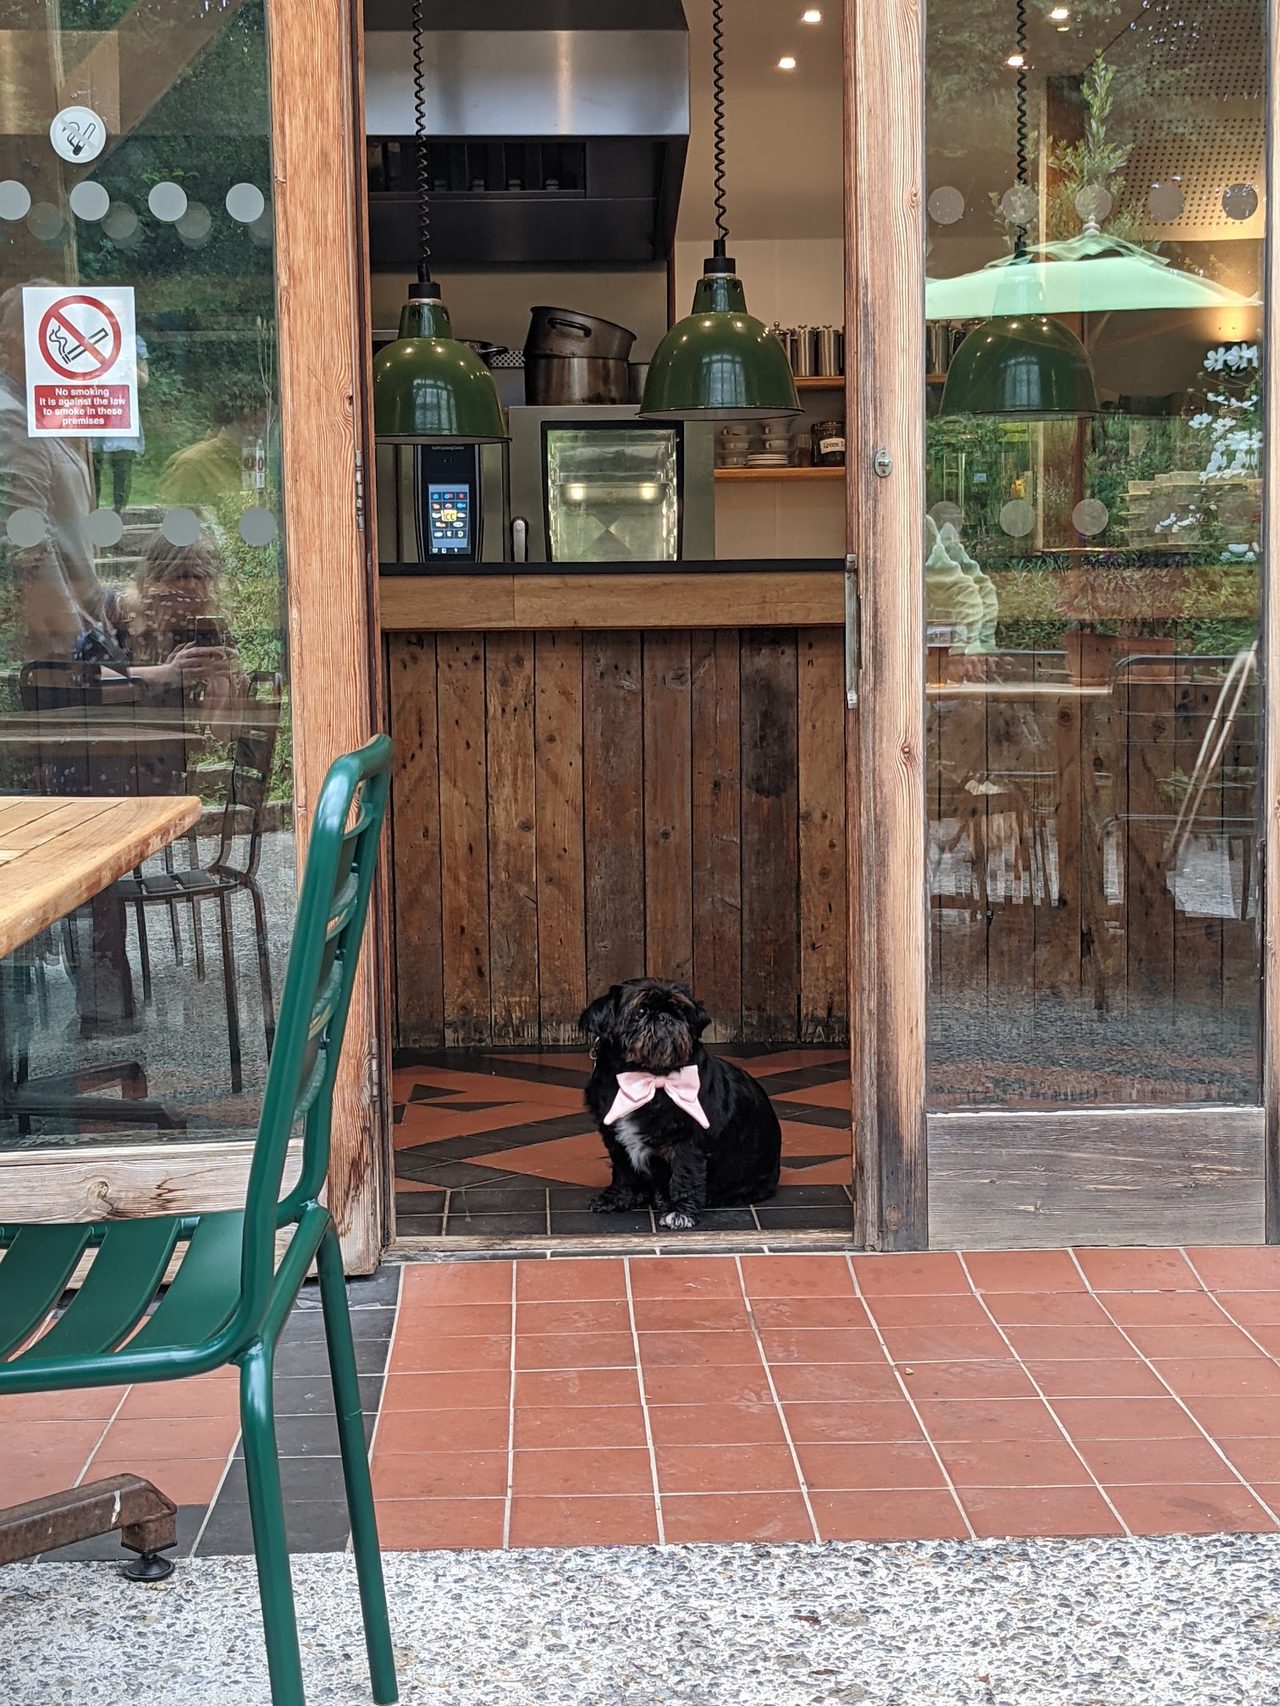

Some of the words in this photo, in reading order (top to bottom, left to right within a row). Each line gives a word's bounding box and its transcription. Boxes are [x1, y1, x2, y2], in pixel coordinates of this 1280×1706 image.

[55, 387, 69, 396] No
[70, 386, 110, 397] smoking
[39, 398, 46, 406] It
[48, 398, 56, 406] is
[58, 397, 91, 408] against
[93, 397, 108, 406] the
[110, 397, 126, 406] law
[43, 407, 52, 416] to
[54, 407, 85, 416] smoke
[87, 407, 95, 416] in
[97, 407, 123, 416] these
[62, 416, 105, 427] premises
